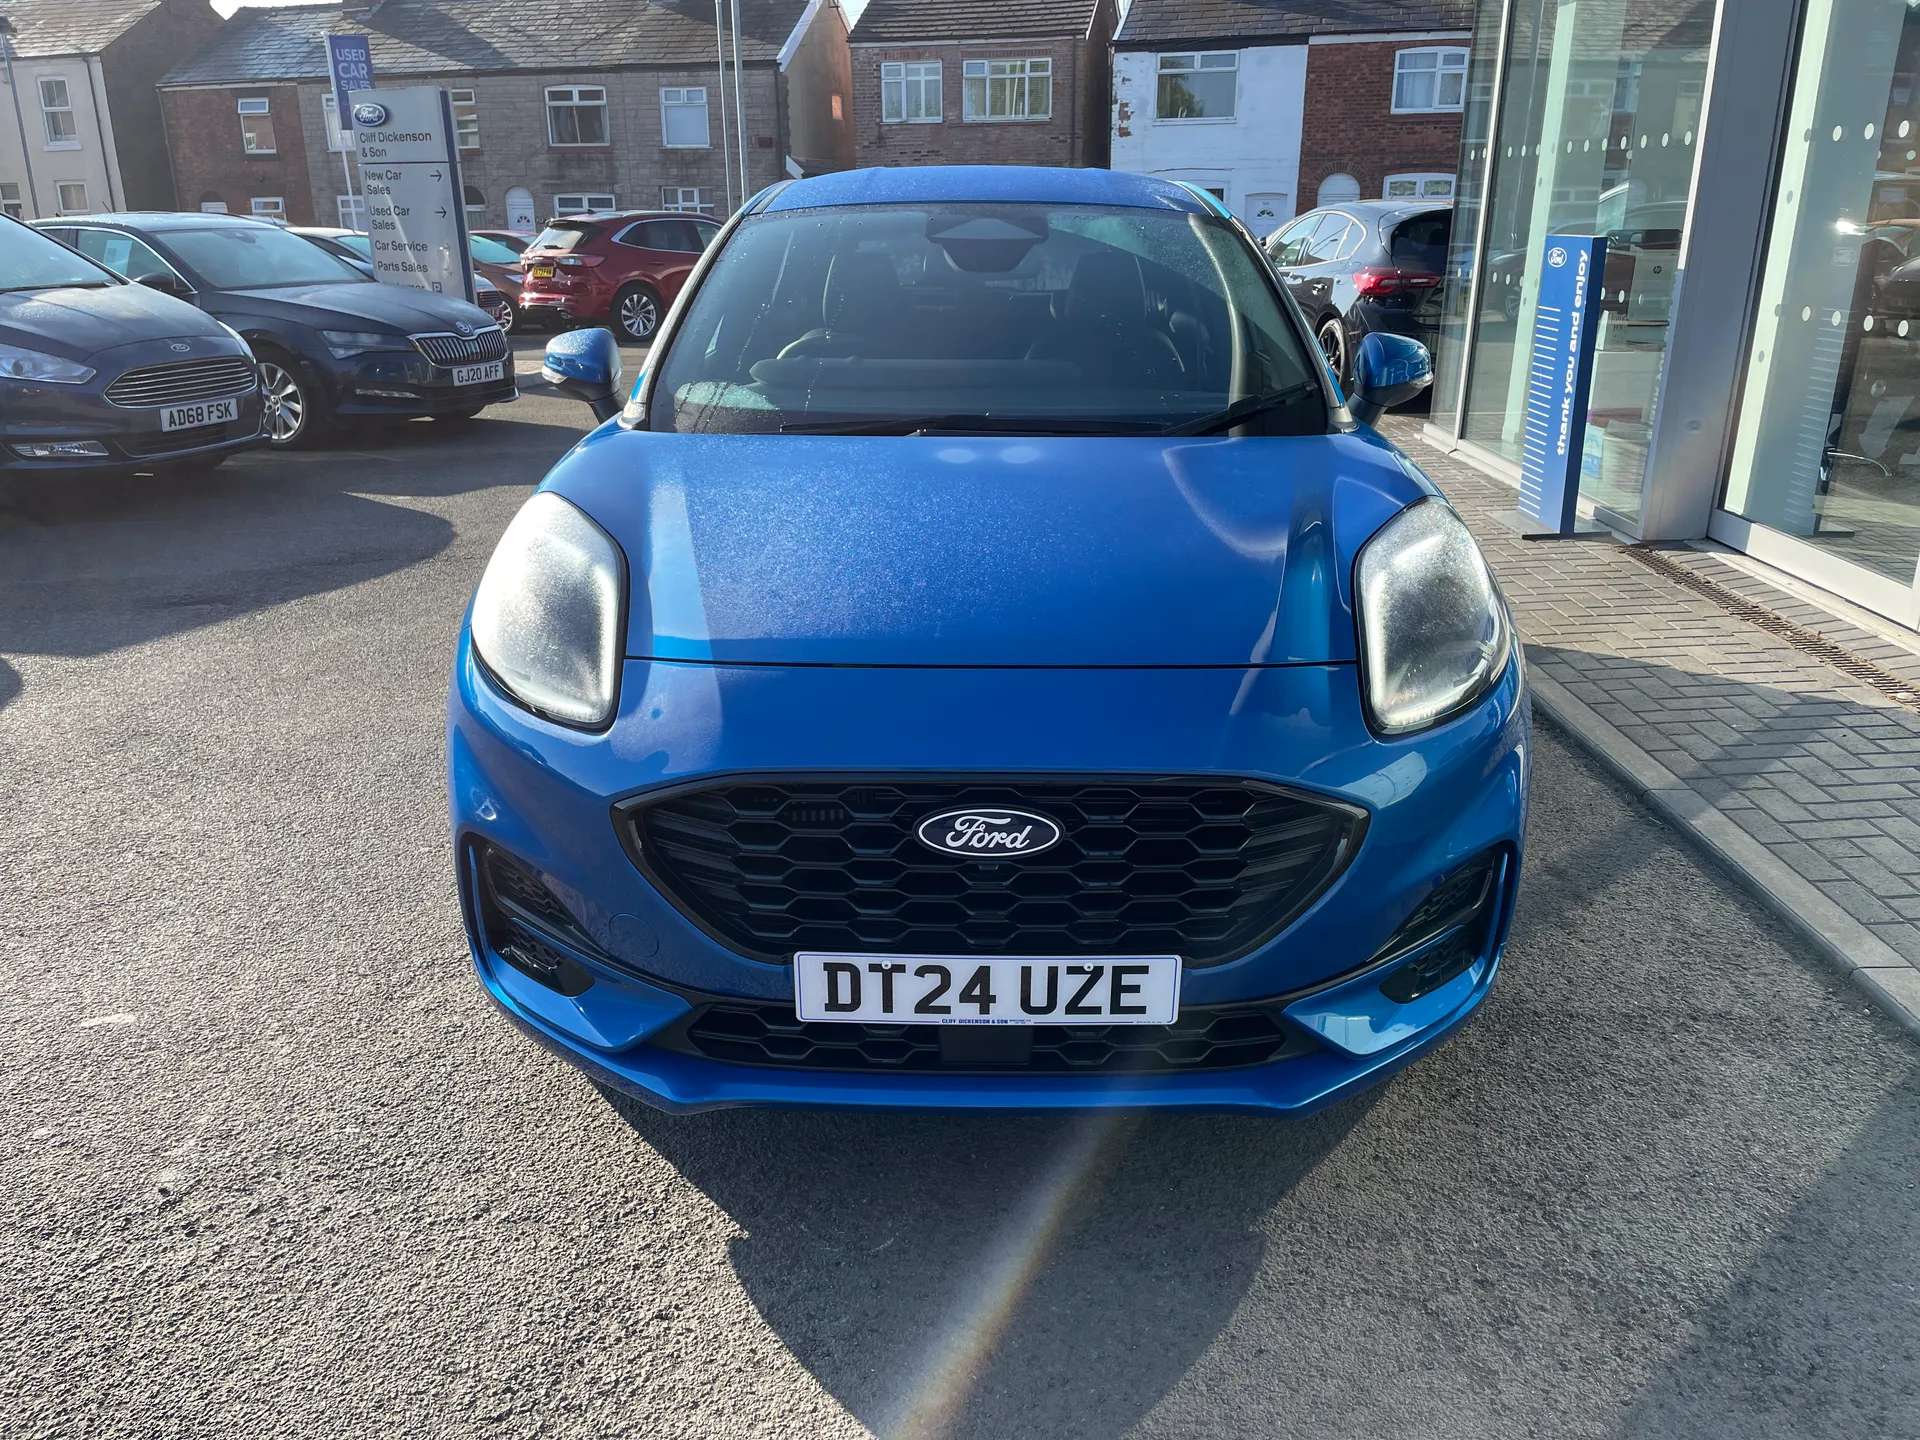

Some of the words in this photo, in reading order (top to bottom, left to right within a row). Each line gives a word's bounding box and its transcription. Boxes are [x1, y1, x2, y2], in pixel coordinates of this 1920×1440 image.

[336, 48, 366, 61] USED
[338, 62, 369, 79] CAR
[341, 80, 371, 91] SALES
[360, 132, 376, 144] Cliff
[377, 131, 432, 143] Dickenson
[361, 147, 368, 158] &
[369, 146, 387, 158] Son
[365, 170, 384, 181] New
[385, 169, 402, 181] Car
[367, 184, 391, 195] Sales
[369, 205, 392, 217] Used
[393, 205, 410, 217] Car
[371, 219, 396, 231] Sales
[375, 240, 390, 251] Car
[391, 240, 428, 252] Service
[377, 261, 400, 272] Parts
[401, 261, 429, 273] Sales
[1574, 250, 1589, 308] enjoy
[1569, 311, 1581, 352] and
[457, 367, 482, 383] GJ20
[484, 364, 499, 379] AFF
[1564, 356, 1576, 394] you
[168, 406, 205, 428] AD68
[207, 401, 233, 422] FSK
[1557, 396, 1570, 455] thank
[945, 815, 1033, 849] Ford
[823, 962, 997, 1015] DT24
[1020, 965, 1150, 1016] UZE
